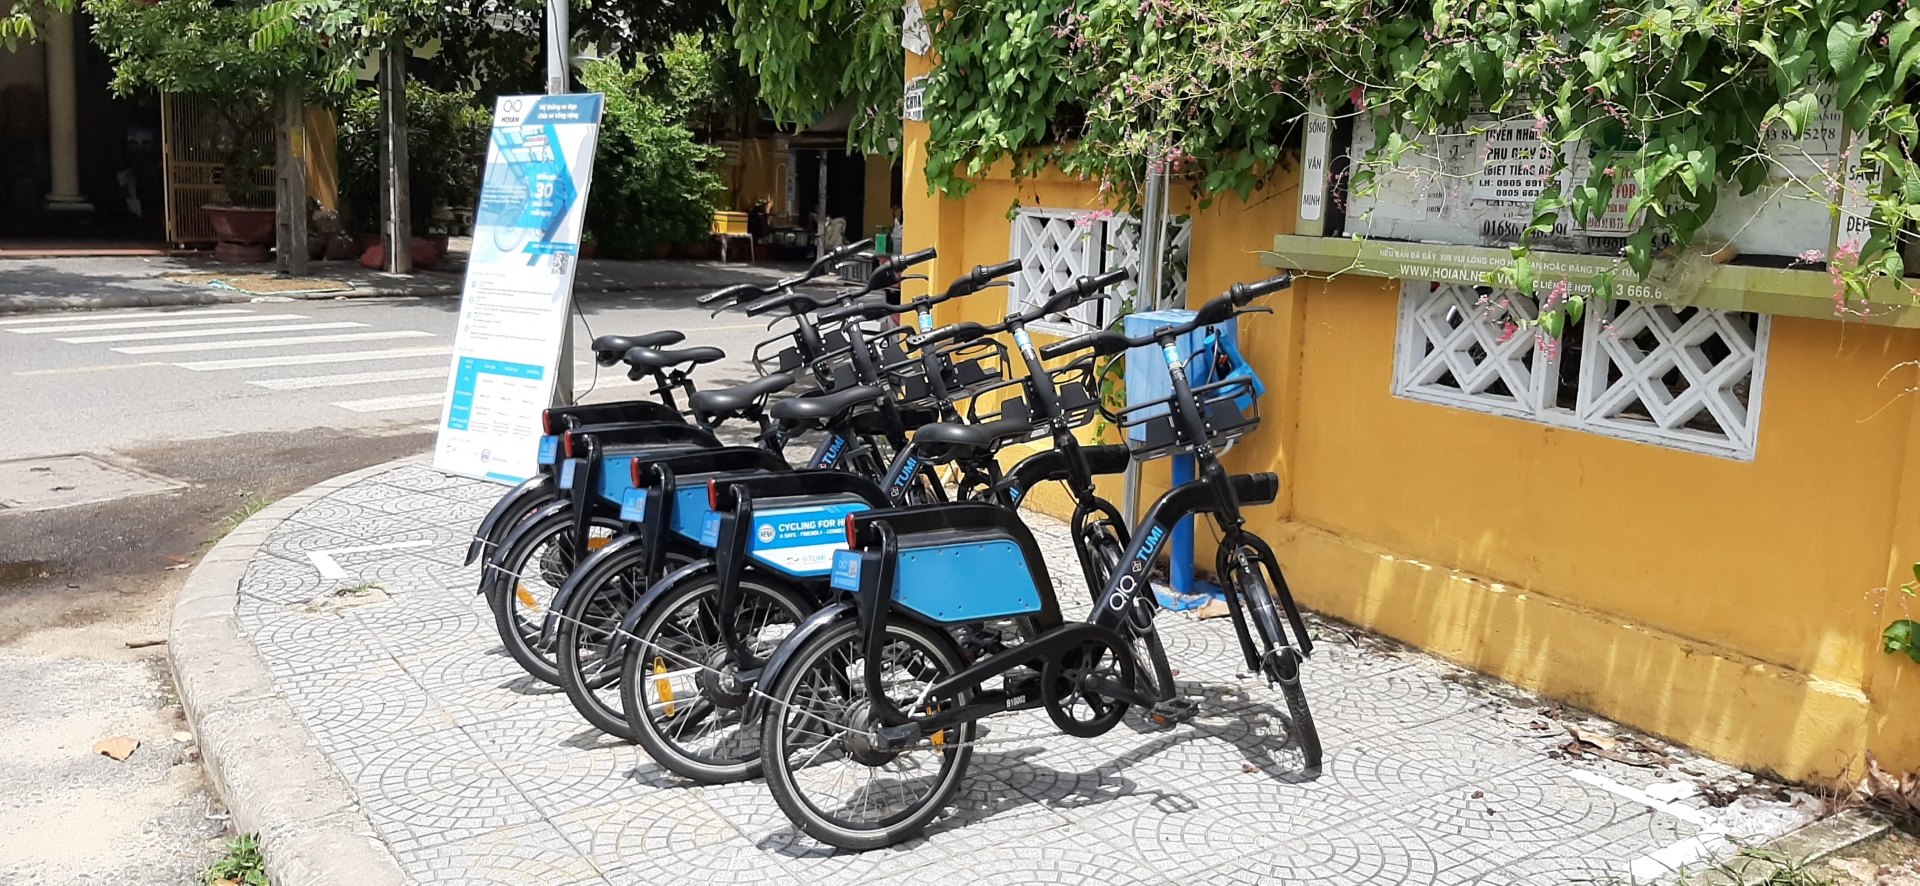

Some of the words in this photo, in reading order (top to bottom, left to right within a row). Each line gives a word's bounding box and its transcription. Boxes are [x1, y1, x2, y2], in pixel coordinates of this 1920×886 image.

[1309, 117, 1326, 133] SỐNG
[1308, 156, 1321, 169] VĂN
[1480, 179, 1493, 187] LH:
[535, 182, 553, 199] 30
[1303, 194, 1320, 206] MINH
[1453, 256, 1465, 264] VUI
[822, 437, 845, 465] TUMI
[895, 457, 918, 487] TUMI
[778, 520, 816, 532] CYCLING
[818, 519, 835, 529] FOR
[1136, 525, 1164, 562] TUMI
